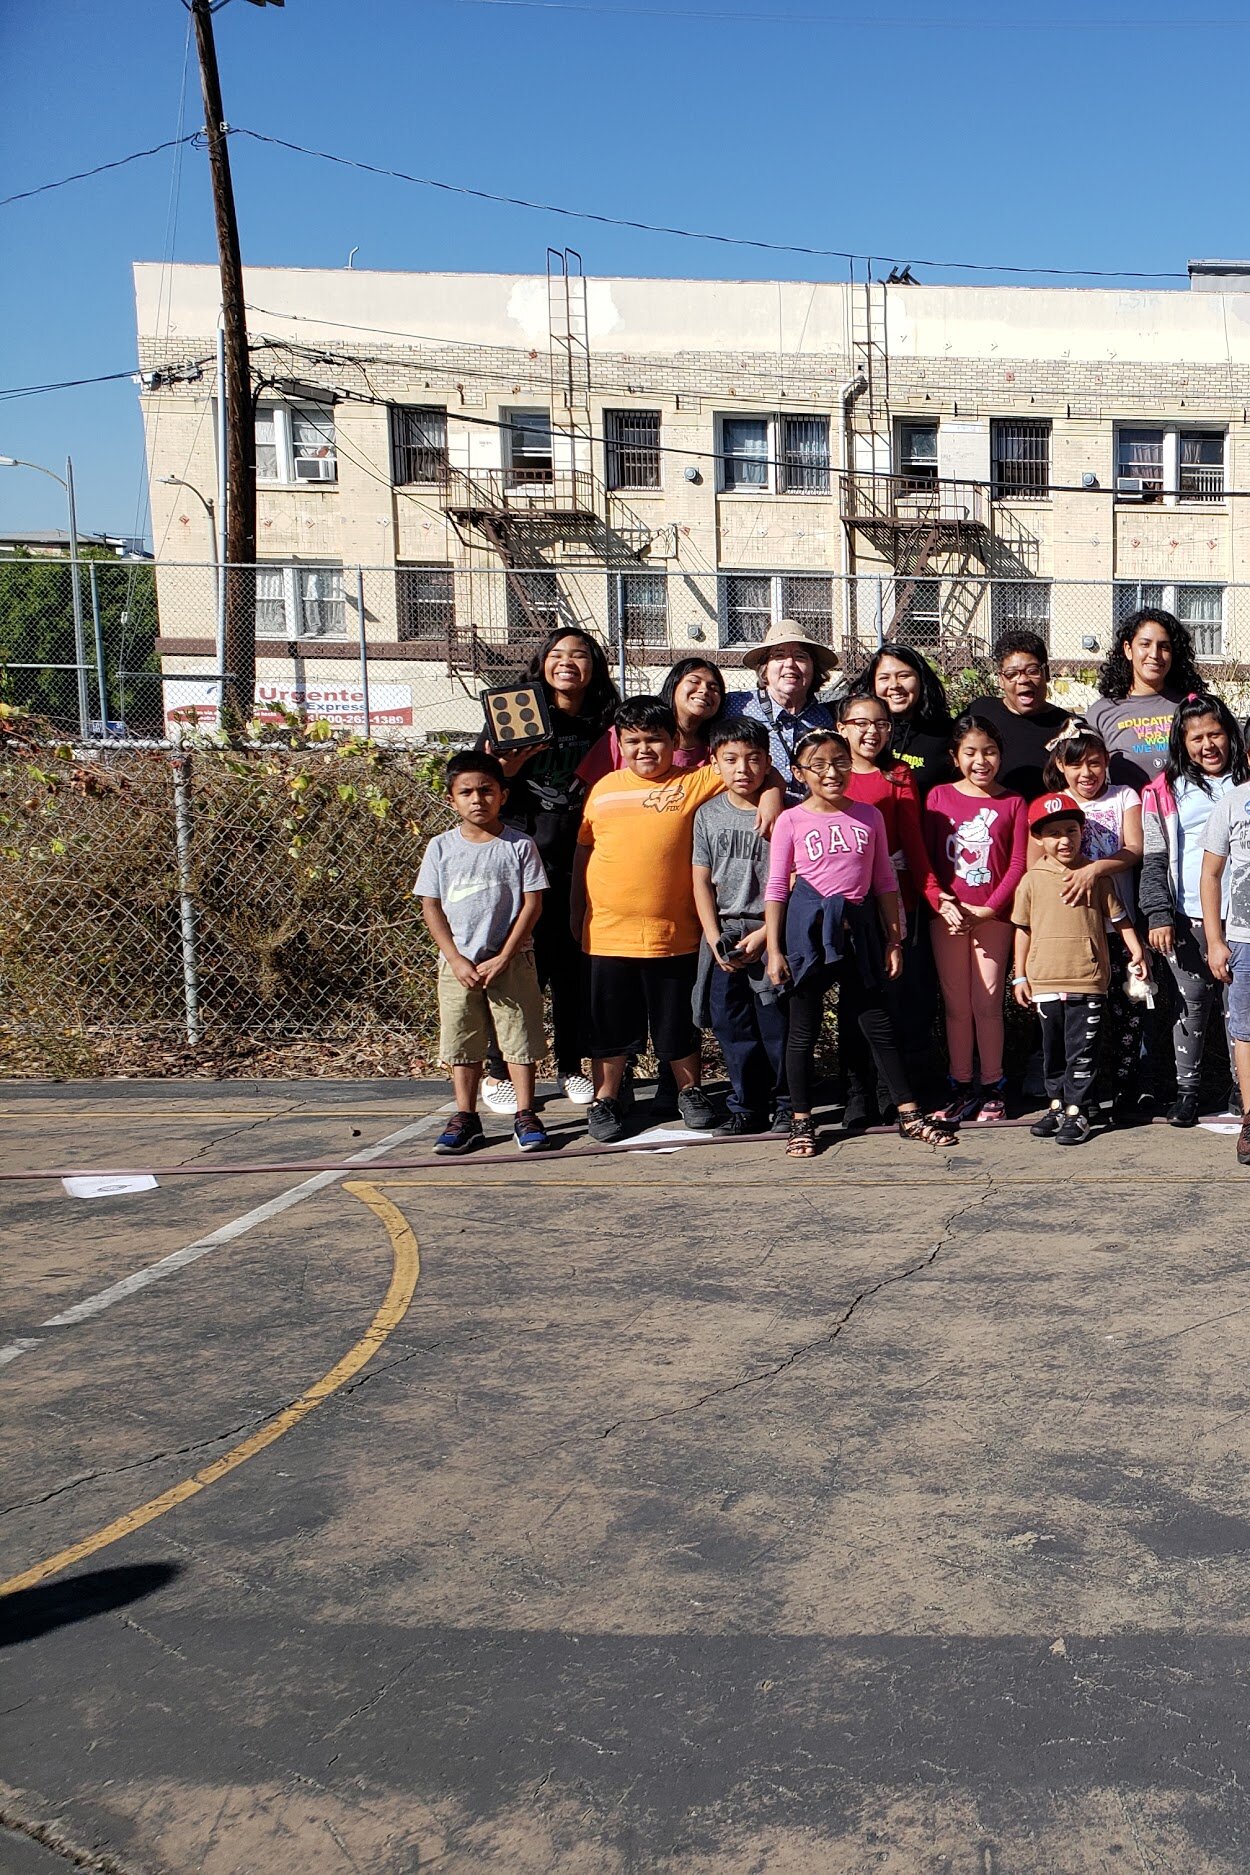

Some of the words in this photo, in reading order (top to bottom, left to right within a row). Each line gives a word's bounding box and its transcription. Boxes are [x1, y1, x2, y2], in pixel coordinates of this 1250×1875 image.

[259, 686, 364, 704] Urgente
[307, 702, 367, 713] Express
[1137, 731, 1161, 740] FOR
[1240, 830, 1249, 840] OF
[804, 825, 869, 861] GAP
[1073, 1002, 1101, 1078] JORAN
